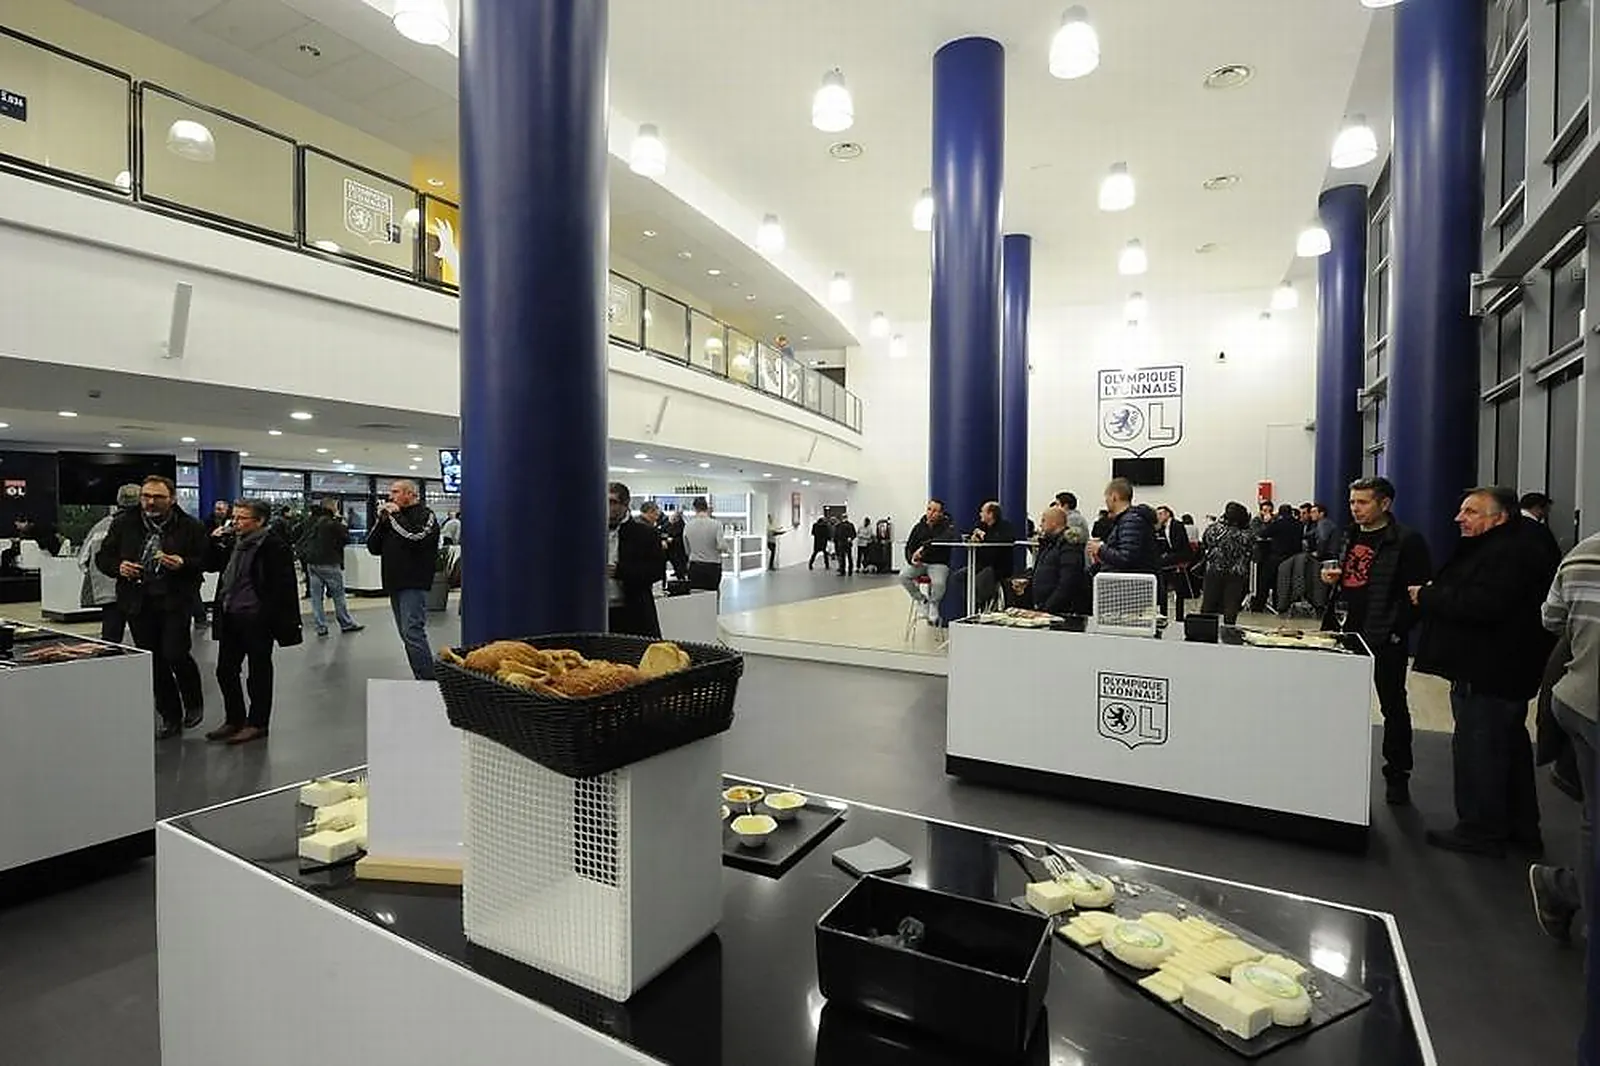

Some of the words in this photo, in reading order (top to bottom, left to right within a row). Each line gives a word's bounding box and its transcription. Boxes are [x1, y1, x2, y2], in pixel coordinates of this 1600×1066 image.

[1104, 371, 1177, 385] OLYMPIQUE
[6, 486, 26, 496] OL
[1103, 677, 1163, 691] OLYMPIQUE
[1103, 686, 1164, 700] LYONNAIS
